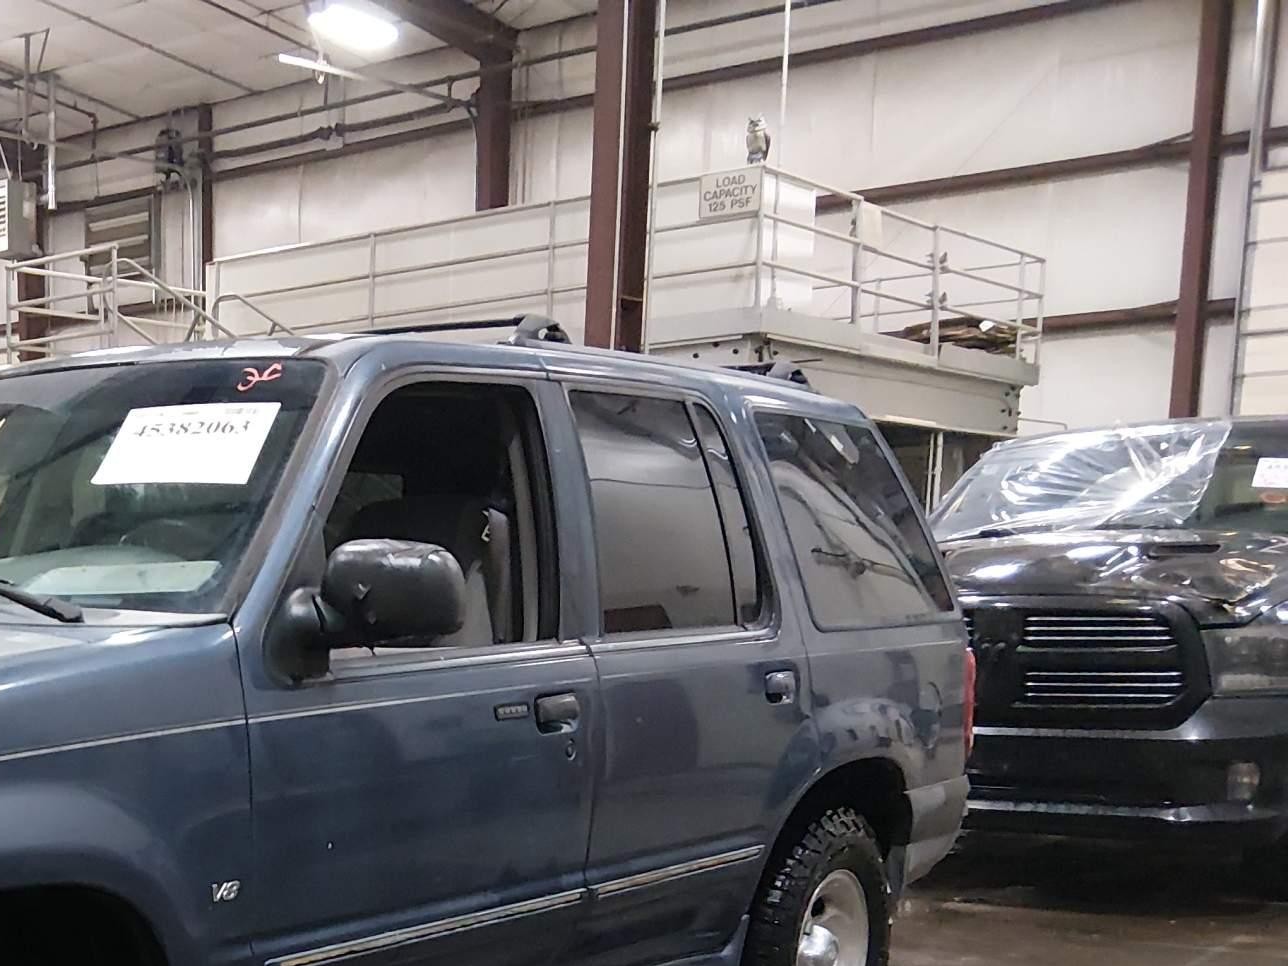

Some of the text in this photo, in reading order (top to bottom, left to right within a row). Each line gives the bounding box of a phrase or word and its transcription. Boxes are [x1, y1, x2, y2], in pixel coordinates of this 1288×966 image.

[715, 174, 746, 188] LOAD
[703, 184, 758, 201] CAPACITY
[708, 196, 753, 212] 125 PSF
[134, 420, 250, 437] 45382063
